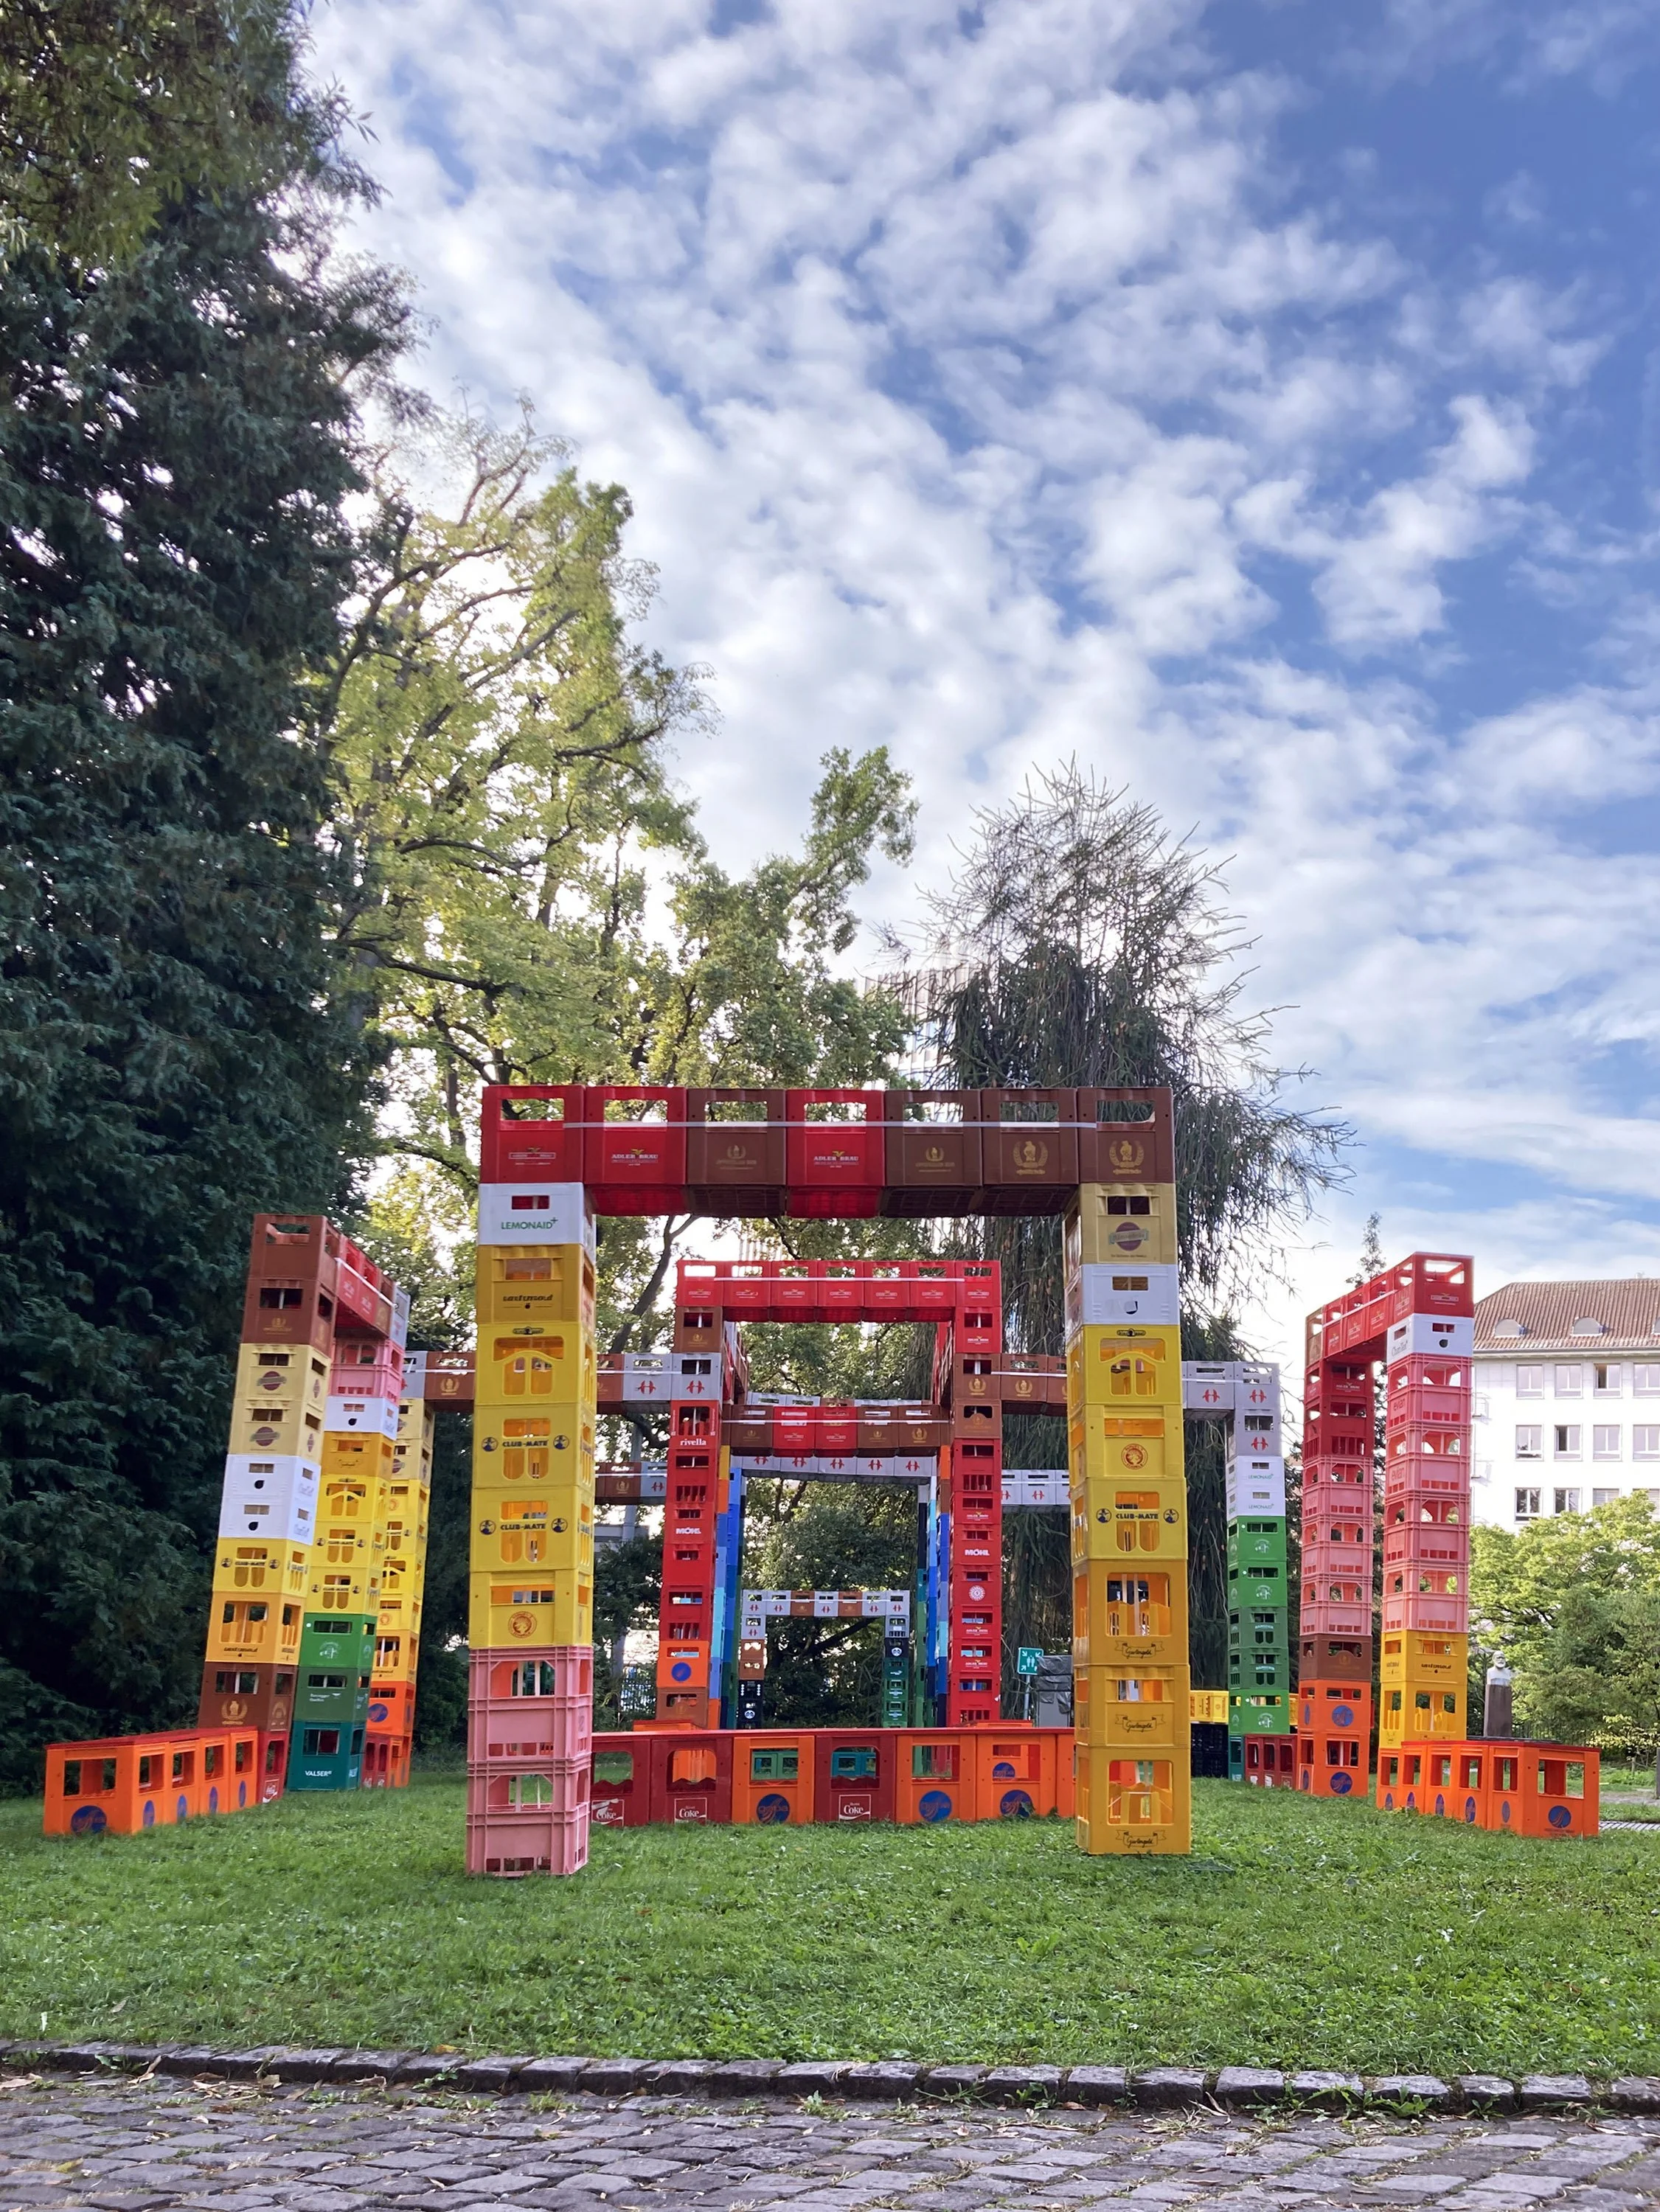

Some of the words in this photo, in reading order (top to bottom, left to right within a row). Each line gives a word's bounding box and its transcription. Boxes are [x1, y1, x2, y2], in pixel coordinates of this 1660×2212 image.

[680, 1438, 706, 1446] rivella
[596, 1809, 617, 1820] Coke
[679, 1808, 700, 1818] Coke
[843, 1804, 864, 1815] Coke
